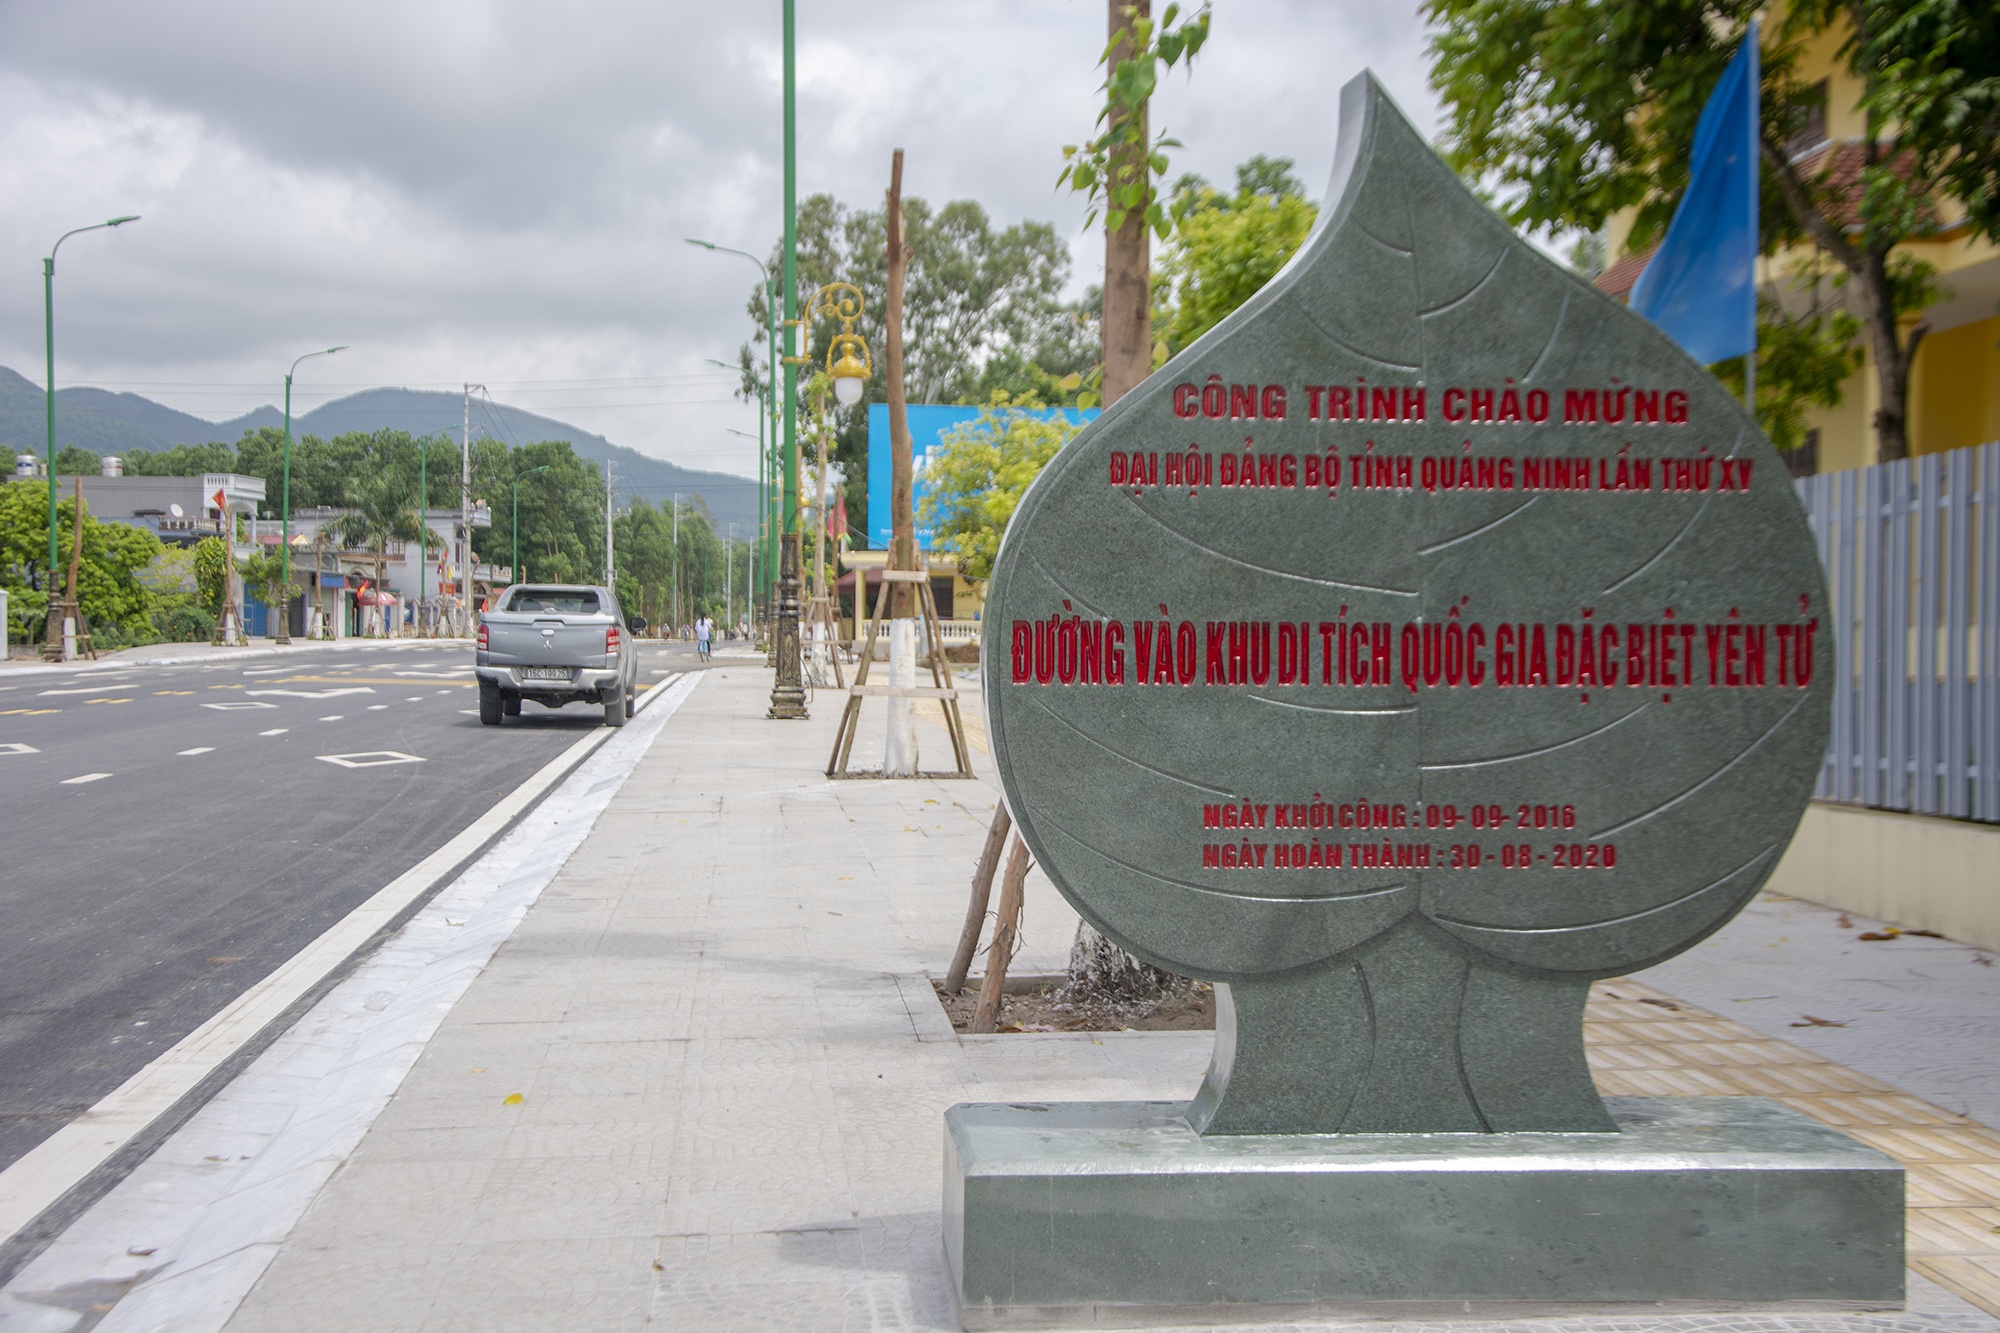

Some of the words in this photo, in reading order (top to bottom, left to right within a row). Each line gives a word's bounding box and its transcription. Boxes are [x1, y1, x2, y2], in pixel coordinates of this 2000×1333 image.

[1173, 374, 1287, 421] CÔNG
[1304, 376, 1427, 424] TRÌNH
[1442, 377, 1551, 426] CHÀO
[1563, 377, 1690, 427] MỪNG
[1110, 451, 1158, 497] ĐẠI
[1165, 442, 1213, 498] HỘI
[1219, 436, 1298, 490] ĐẢNG
[1304, 444, 1342, 499] BỘ
[1349, 439, 1414, 493] TỈNH
[1420, 440, 1516, 496] QUẢNG
[1521, 456, 1593, 494] NINH
[1660, 446, 1716, 495] THỨ
[1717, 457, 1755, 495] XV
[1011, 599, 1125, 687] ĐƯỜNG
[1133, 603, 1198, 688] VÀO
[1206, 620, 1271, 688] KHU
[1277, 620, 1311, 688] DI
[1318, 604, 1393, 689] TÍCH
[1400, 595, 1487, 695] QUỐC
[1495, 622, 1550, 689] GIA
[1554, 607, 1621, 705] ĐẶC
[1626, 607, 1697, 705] BIỆT
[1704, 607, 1768, 690] YÊN
[1774, 593, 1819, 690] TỬ
[1203, 797, 1269, 830] NGÀY
[1274, 792, 1335, 830] KHỞI
[1338, 797, 1407, 831] CÔNG
[1203, 837, 1268, 870] NGÀY
[1273, 837, 1343, 870] HOÀN
[1348, 837, 1431, 870] THÀNH
